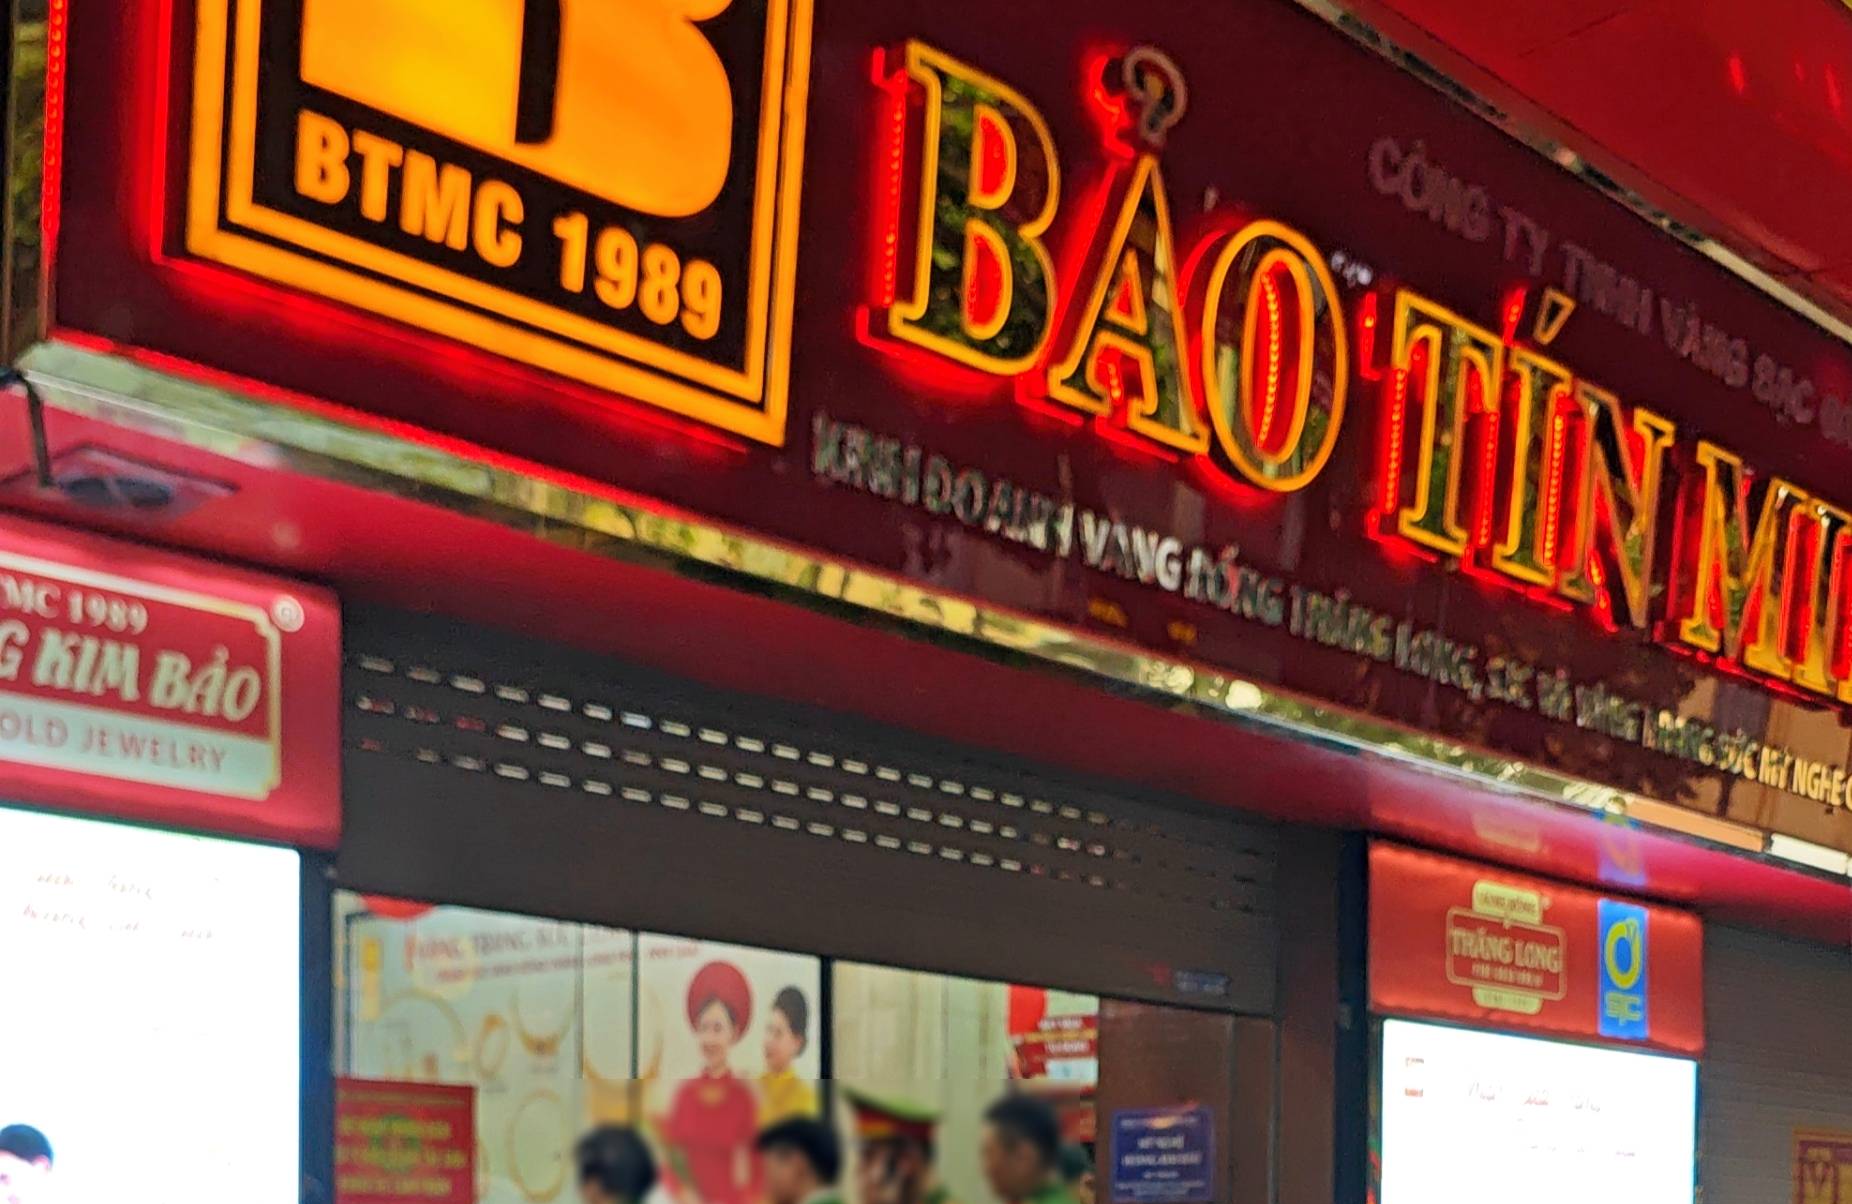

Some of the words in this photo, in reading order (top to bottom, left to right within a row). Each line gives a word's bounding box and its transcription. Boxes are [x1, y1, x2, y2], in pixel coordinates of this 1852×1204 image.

[293, 108, 526, 268] BTMC
[552, 210, 725, 341] 1989
[887, 40, 1349, 493] BẢO
[1392, 287, 1677, 630] TÍN
[1679, 440, 1852, 703] MI
[67, 589, 148, 636] 1989
[32, 626, 140, 700] KIM
[150, 644, 262, 722] BẢO
[83, 724, 226, 773] JEWELRY
